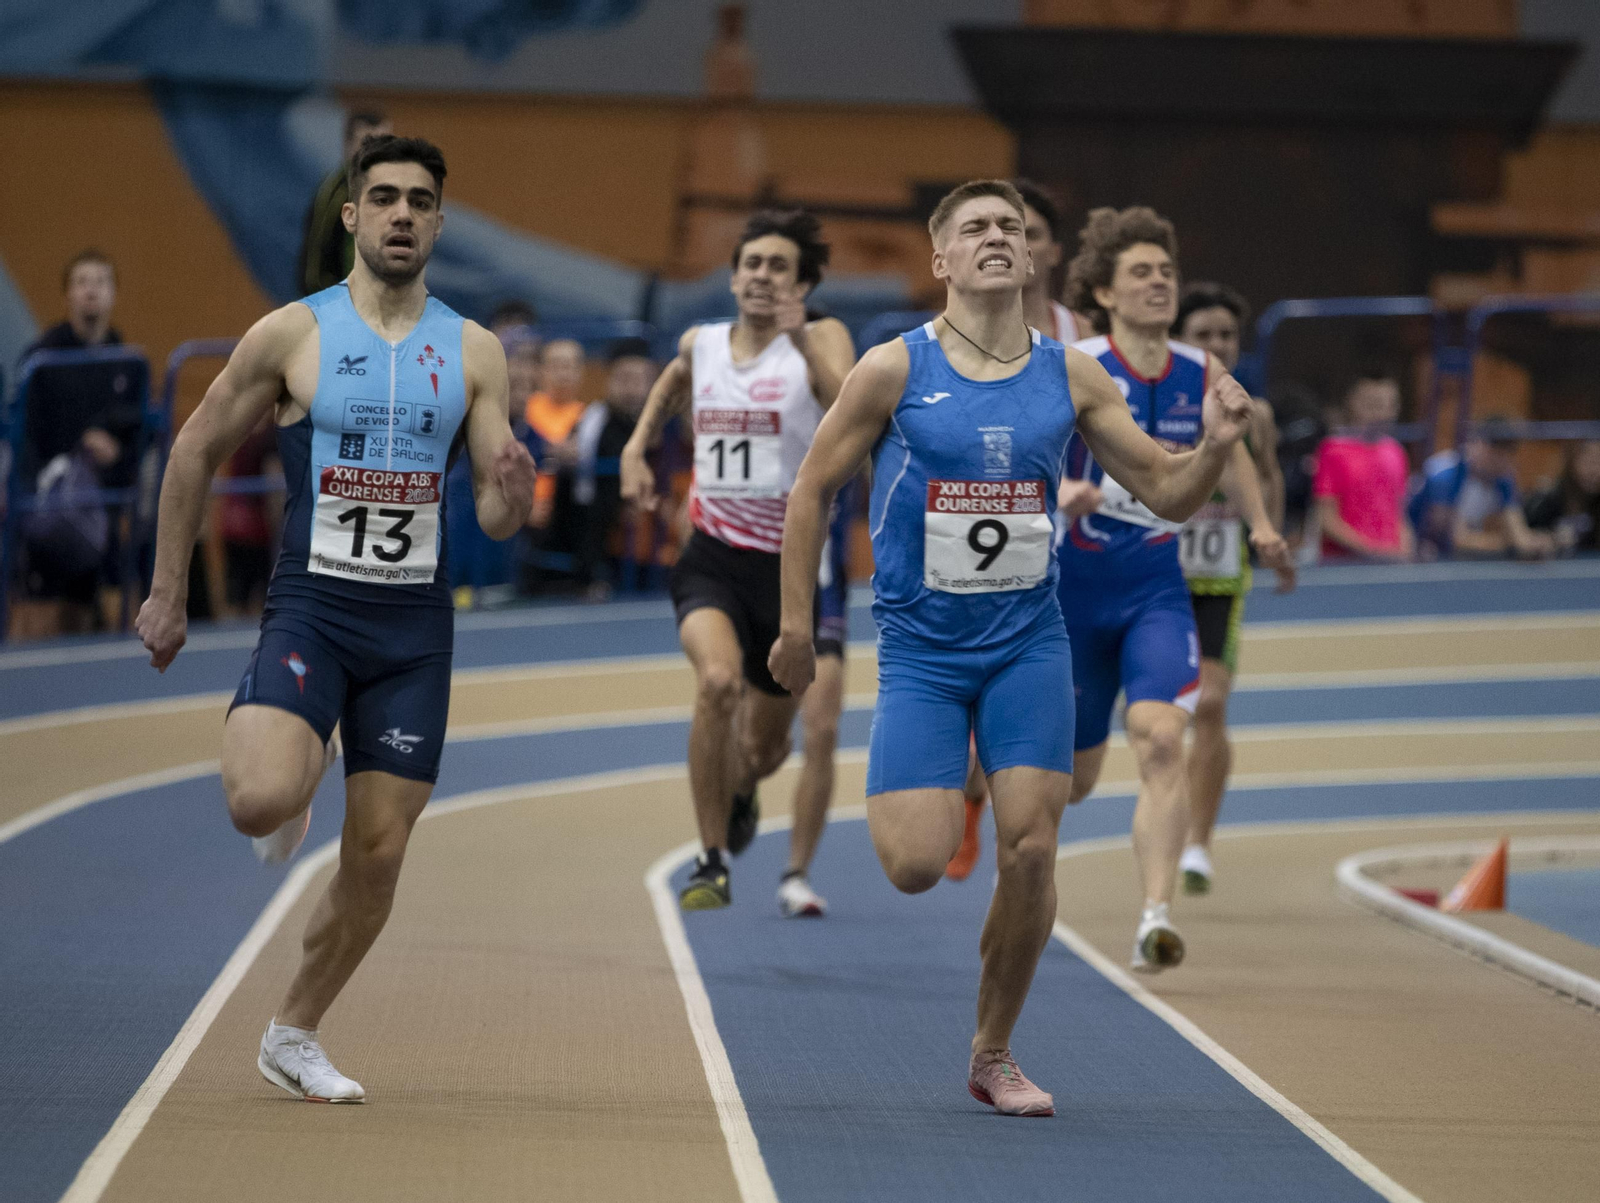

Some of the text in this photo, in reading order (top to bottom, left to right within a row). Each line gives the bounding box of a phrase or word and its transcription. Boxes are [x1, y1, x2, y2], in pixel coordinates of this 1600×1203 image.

[336, 367, 366, 376] ZICO
[350, 404, 407, 416] CONCELLO
[355, 416, 400, 426] DE VIGO
[370, 436, 413, 449] XUNTA
[369, 447, 434, 464] DE GALICIA
[708, 439, 750, 479] 11
[332, 466, 431, 487] XXI COPA ABS
[328, 481, 401, 501] OURENSE
[939, 481, 1038, 496] XXI COPA ABS
[935, 497, 1009, 512] OURENSE
[337, 506, 415, 563] 13
[967, 518, 1009, 571] 9
[1184, 528, 1226, 563] 10
[335, 562, 401, 580] atletismo.gal
[378, 735, 413, 753] ZICO
